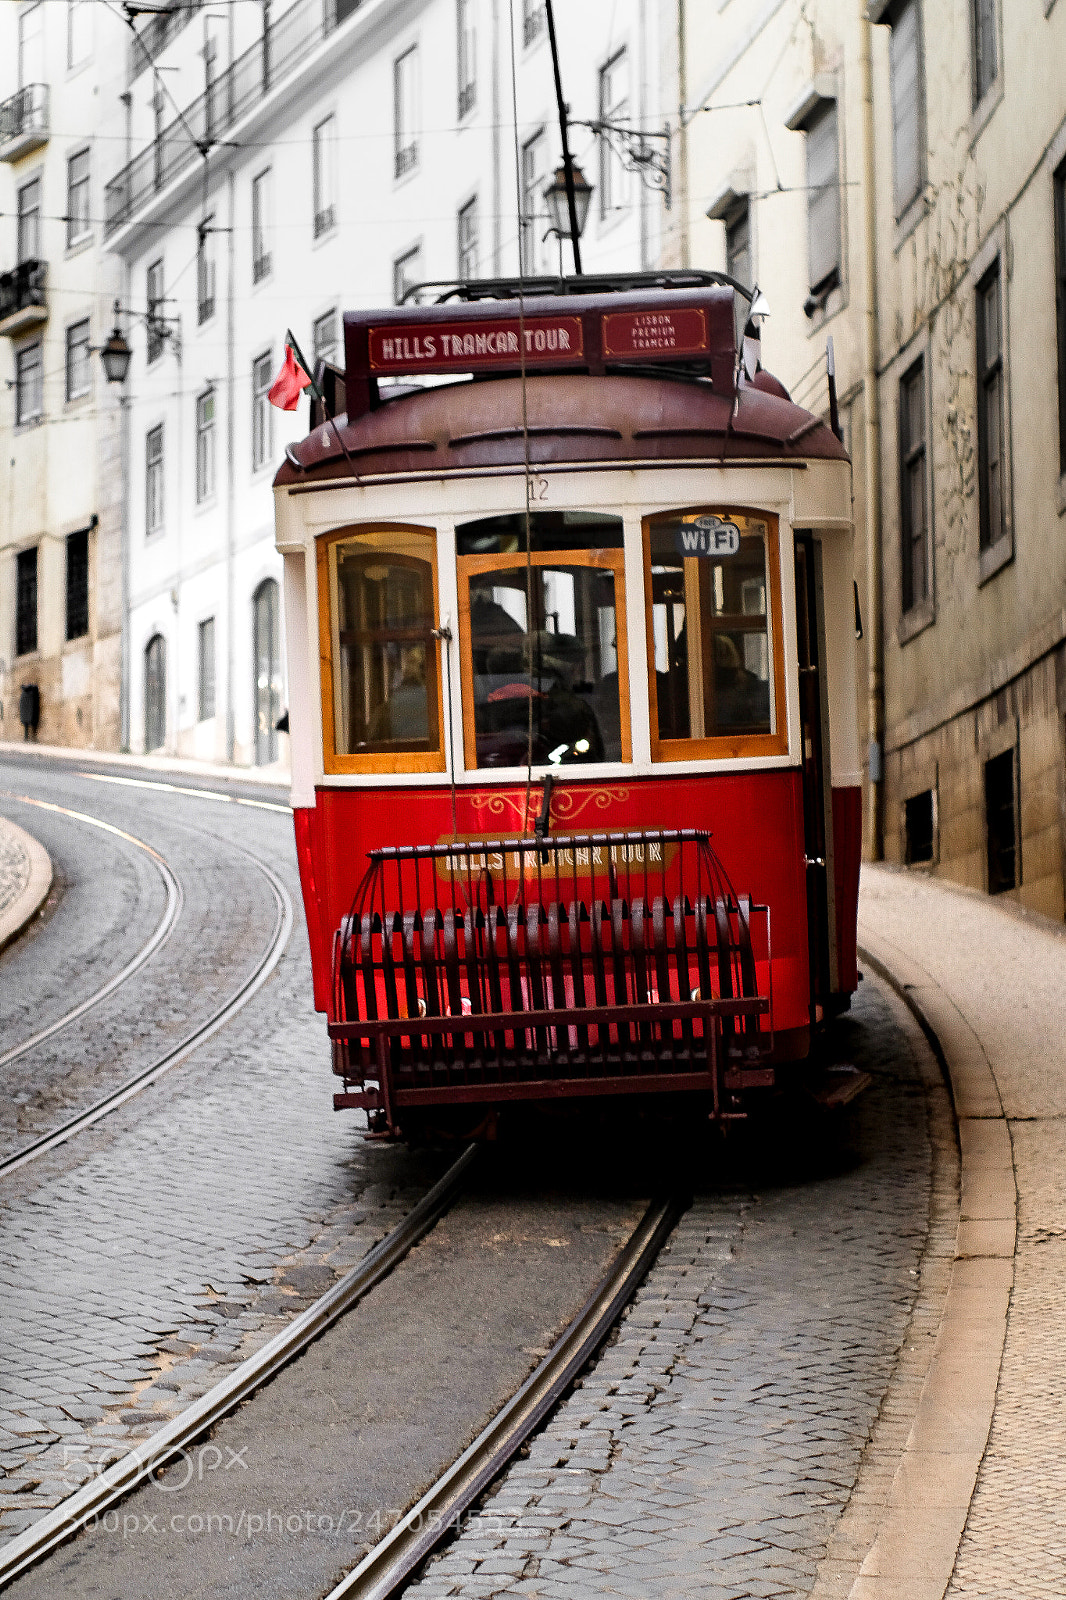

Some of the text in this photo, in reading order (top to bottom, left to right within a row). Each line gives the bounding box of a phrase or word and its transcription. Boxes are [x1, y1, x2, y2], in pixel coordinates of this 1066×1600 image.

[635, 316, 671, 327] LISBON
[631, 326, 676, 337] PREMIUM
[382, 328, 571, 360] HILLS TRAMCAR TOUR
[631, 337, 676, 349] TRAMCAR
